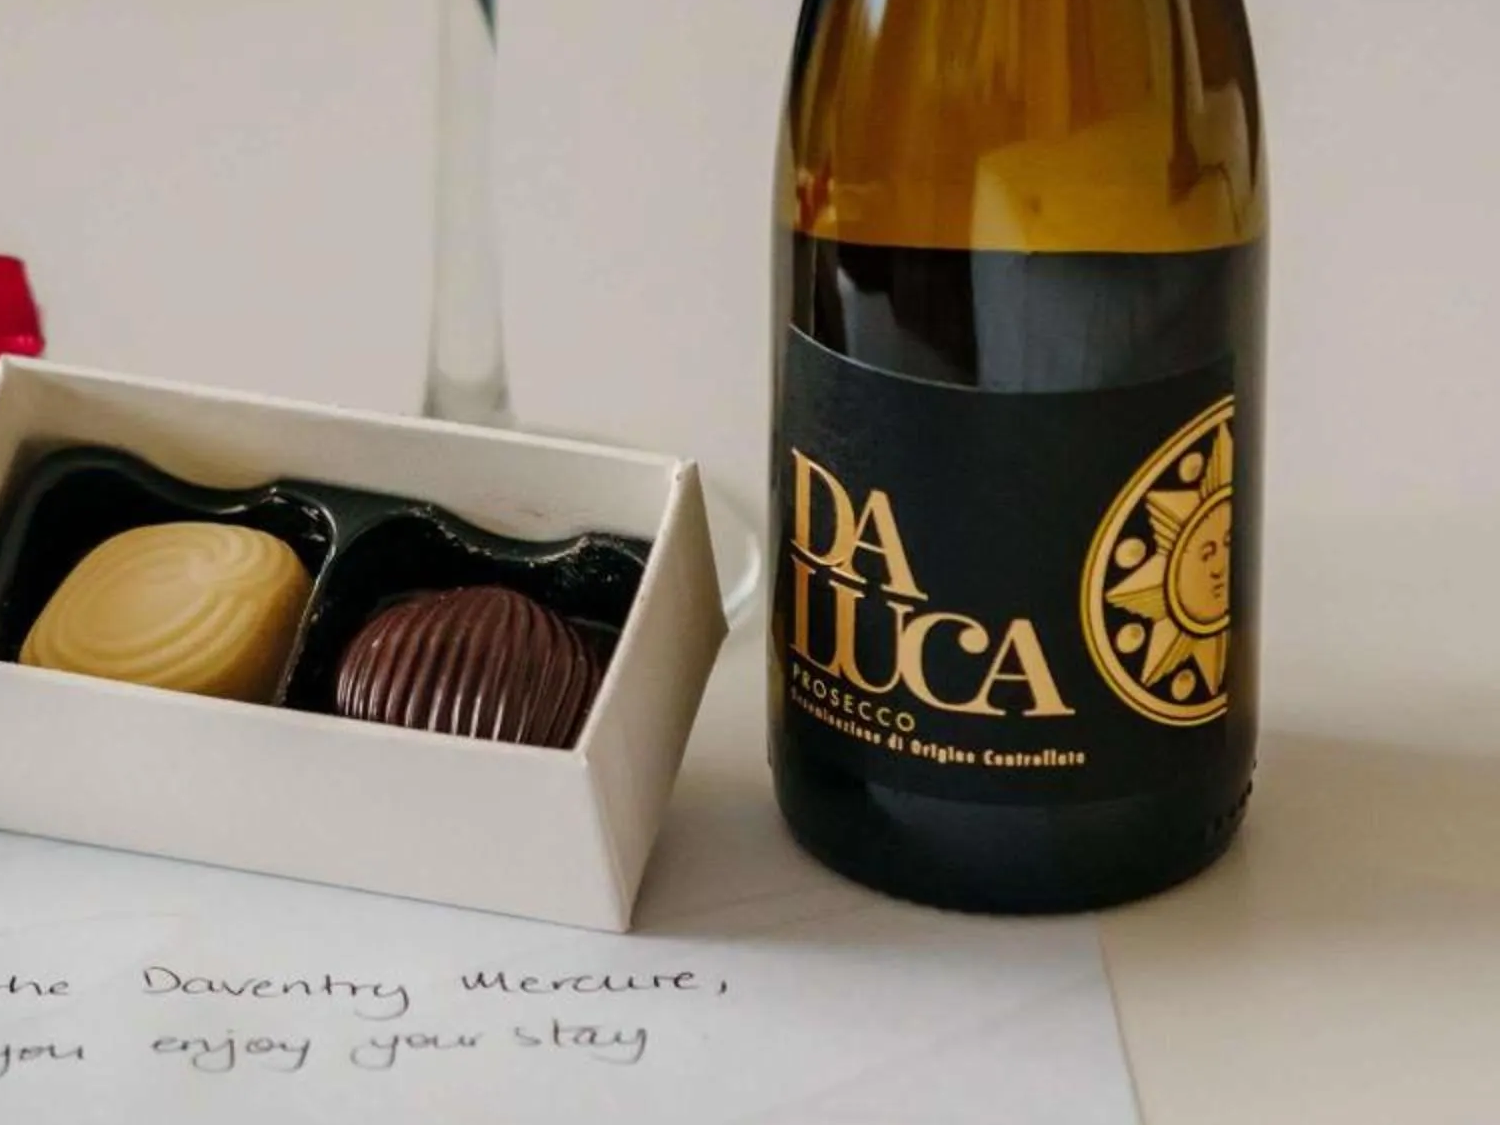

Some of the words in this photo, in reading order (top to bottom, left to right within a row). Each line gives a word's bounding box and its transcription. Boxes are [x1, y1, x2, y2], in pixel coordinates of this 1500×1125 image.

[791, 448, 928, 601] DA
[791, 555, 1075, 717] LUCA
[793, 664, 916, 733] PROSECCO
[888, 735, 904, 752] di
[911, 740, 976, 765] Origine
[142, 966, 412, 1020] Daventry
[152, 1033, 313, 1071] enjoy
[350, 1033, 484, 1069] your
[514, 1018, 649, 1064] stay
